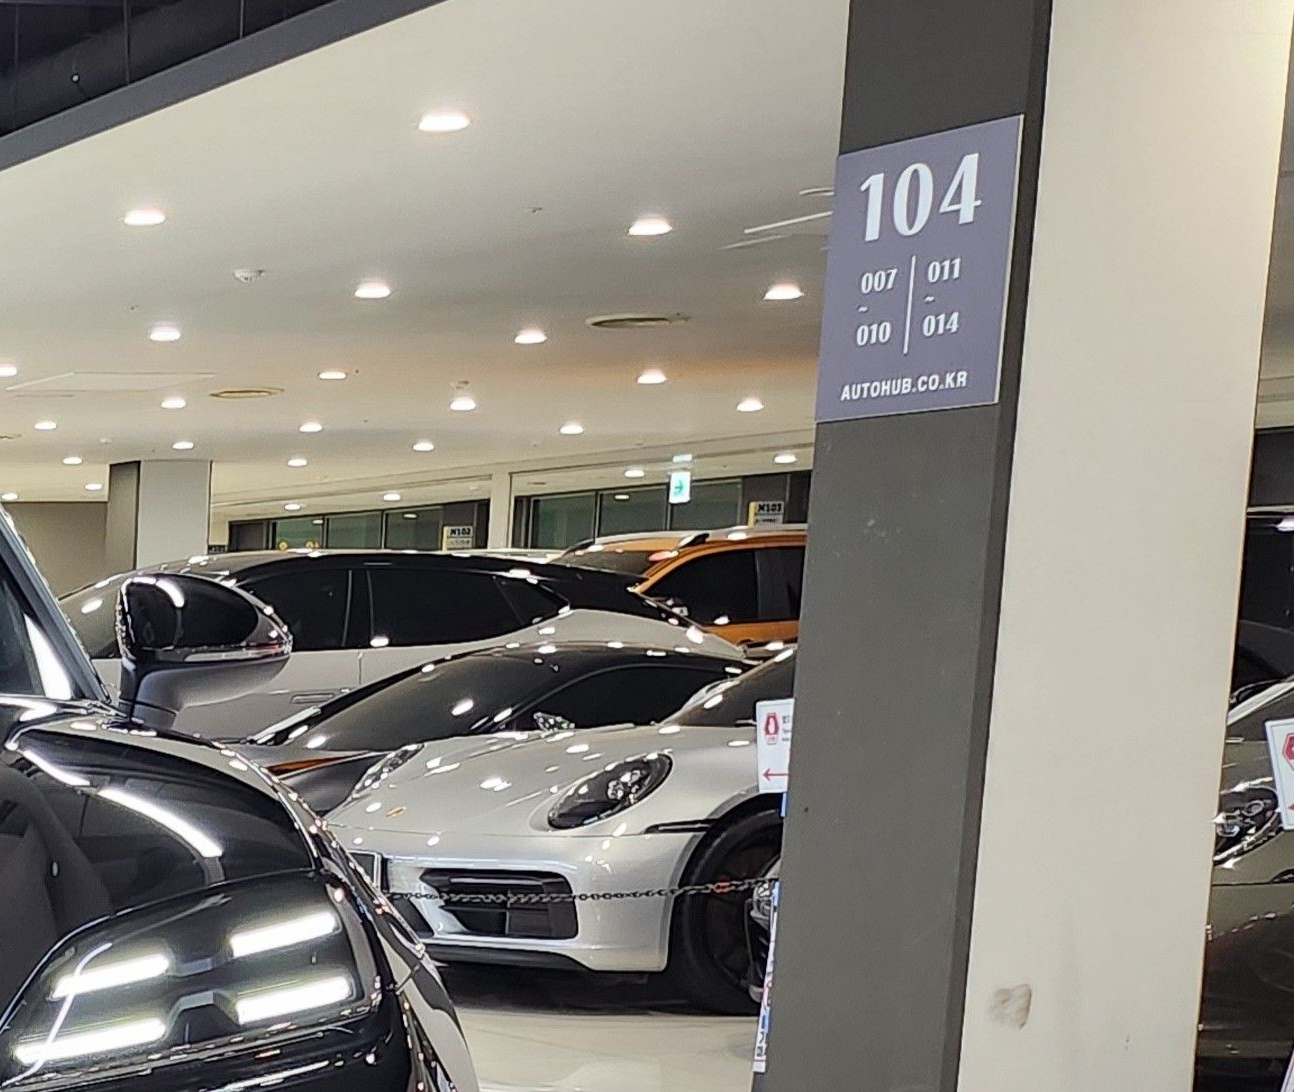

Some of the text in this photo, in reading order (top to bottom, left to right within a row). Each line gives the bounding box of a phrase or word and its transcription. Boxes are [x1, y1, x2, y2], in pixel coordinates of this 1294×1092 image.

[860, 152, 982, 243] 104
[861, 268, 898, 294] 007
[927, 257, 962, 283] 011
[856, 321, 892, 346] 010
[922, 311, 959, 337] 014
[840, 370, 968, 401] AUTOHUB.CO.KR
